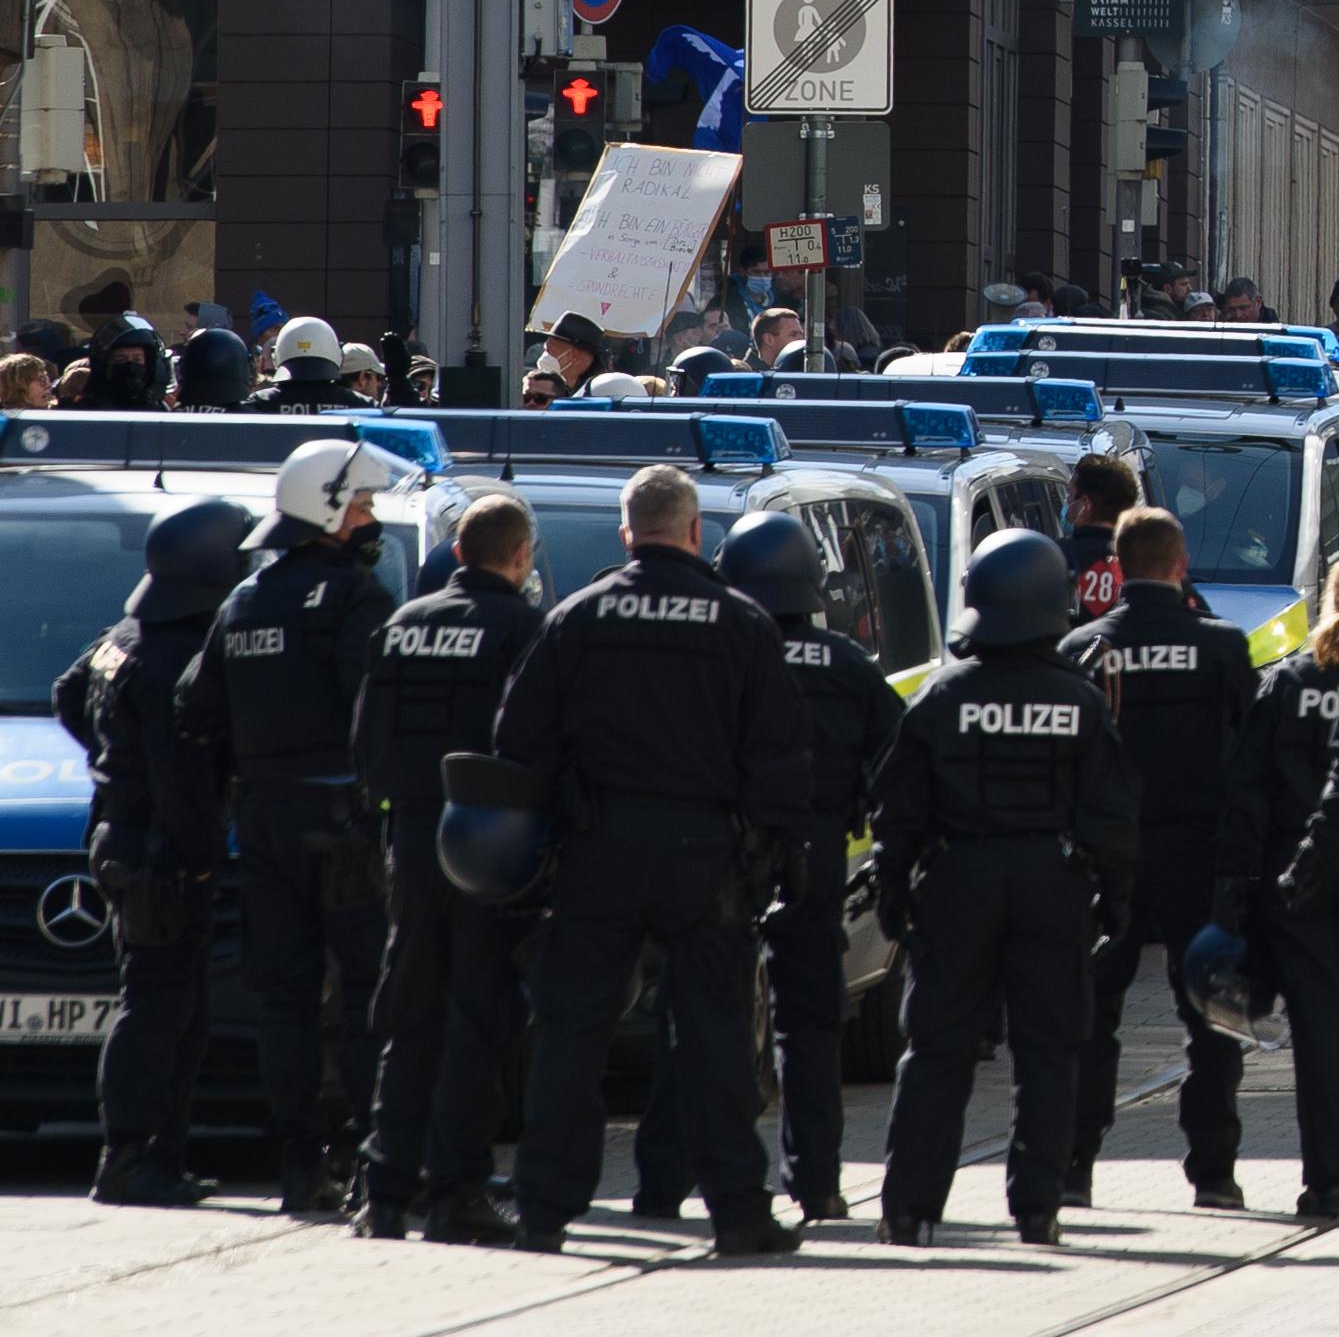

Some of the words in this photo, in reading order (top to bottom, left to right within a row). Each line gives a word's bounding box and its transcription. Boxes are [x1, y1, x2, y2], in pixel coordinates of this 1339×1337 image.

[1091, 7, 1118, 15] WELT
[1091, 18, 1133, 27] KASSEL
[785, 80, 854, 103] ZONE
[649, 159, 673, 176] BIN
[622, 178, 691, 200] RADIKAL
[864, 184, 879, 194] KS
[780, 226, 811, 239] H200
[608, 267, 618, 279] &
[1084, 570, 1113, 602] 28
[597, 593, 719, 623] POLIZEI
[224, 627, 284, 657] POLIZEI
[383, 625, 485, 657] POLIZEI
[1103, 645, 1198, 674] OLIZEI
[959, 703, 1080, 736] POLIZEI
[47, 998, 85, 1031] HP
